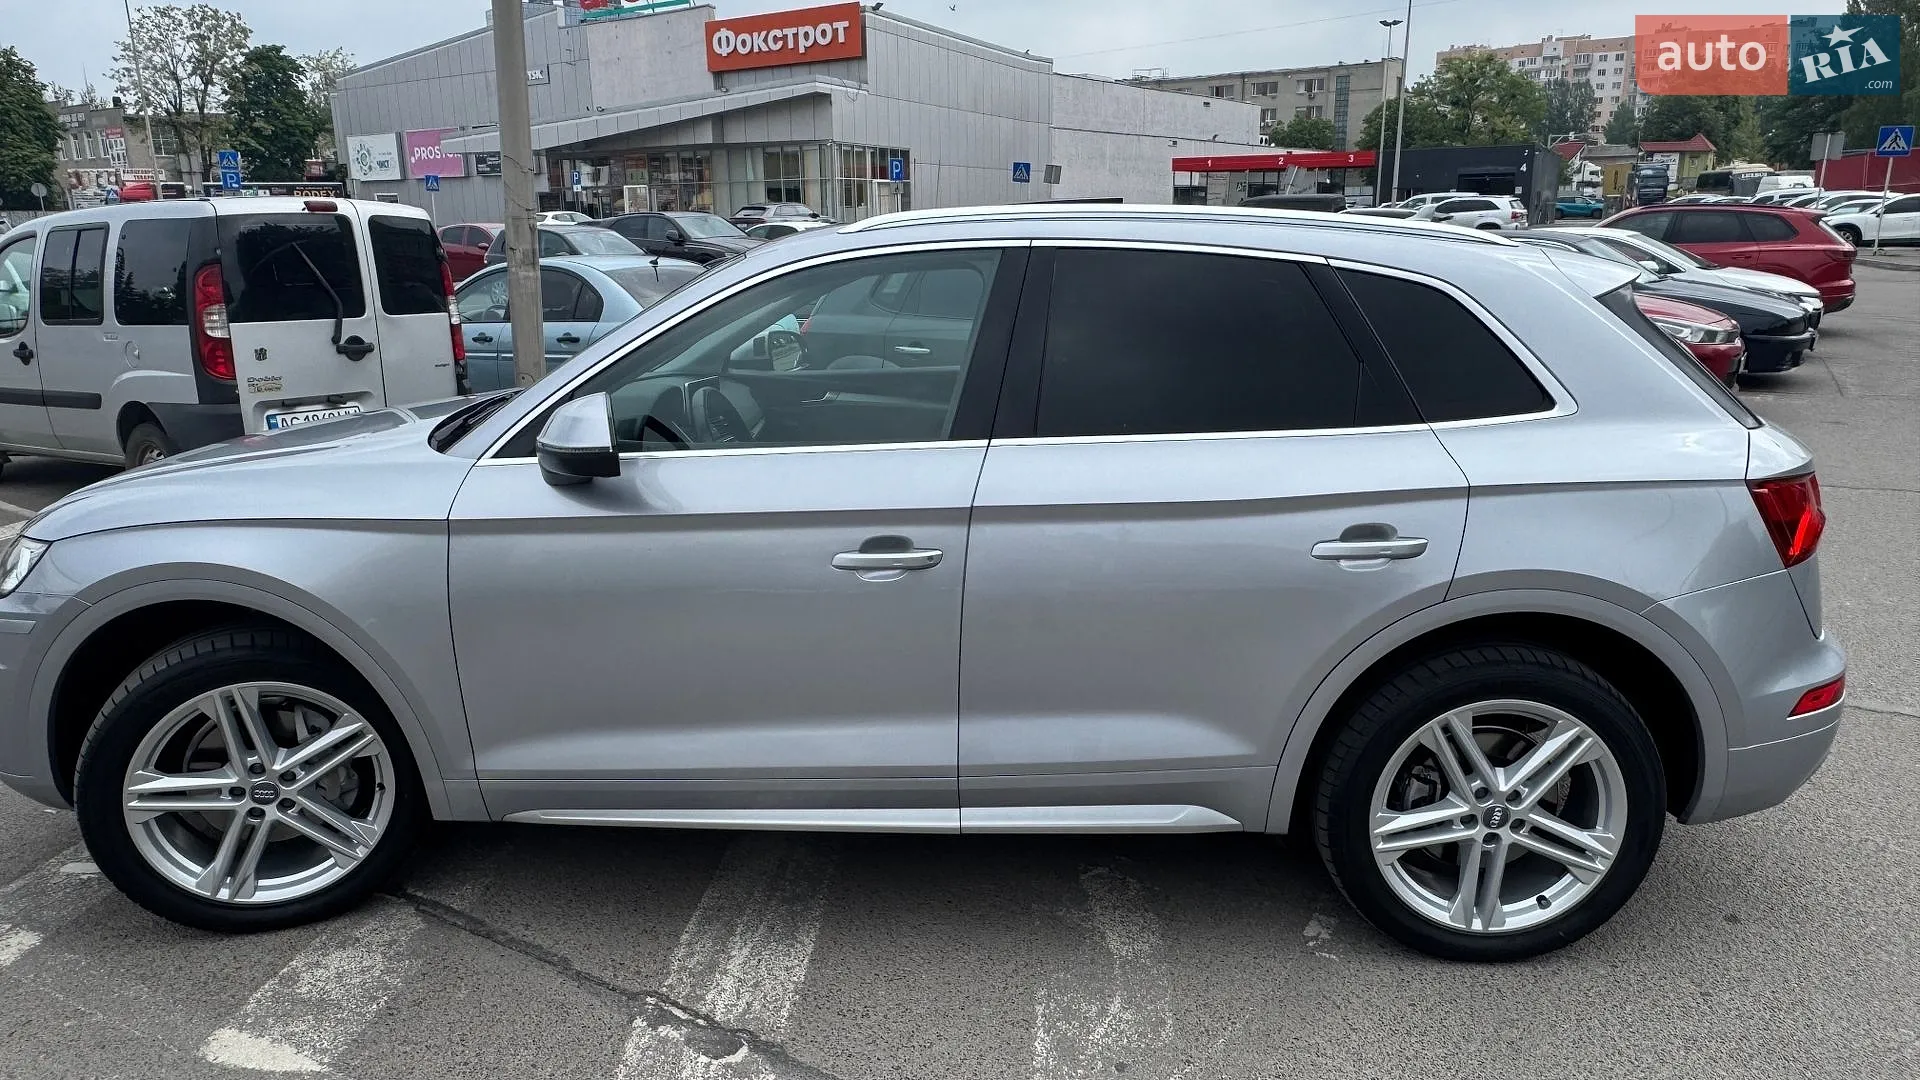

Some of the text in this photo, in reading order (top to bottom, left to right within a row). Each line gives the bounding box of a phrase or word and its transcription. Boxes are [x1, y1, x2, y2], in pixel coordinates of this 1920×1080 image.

[712, 20, 850, 57] Фокстрот
[1207, 159, 1212, 167] 1
[1278, 157, 1284, 165] 2
[1348, 154, 1354, 163] 3
[1519, 163, 1527, 173] 4
[227, 173, 238, 188] P
